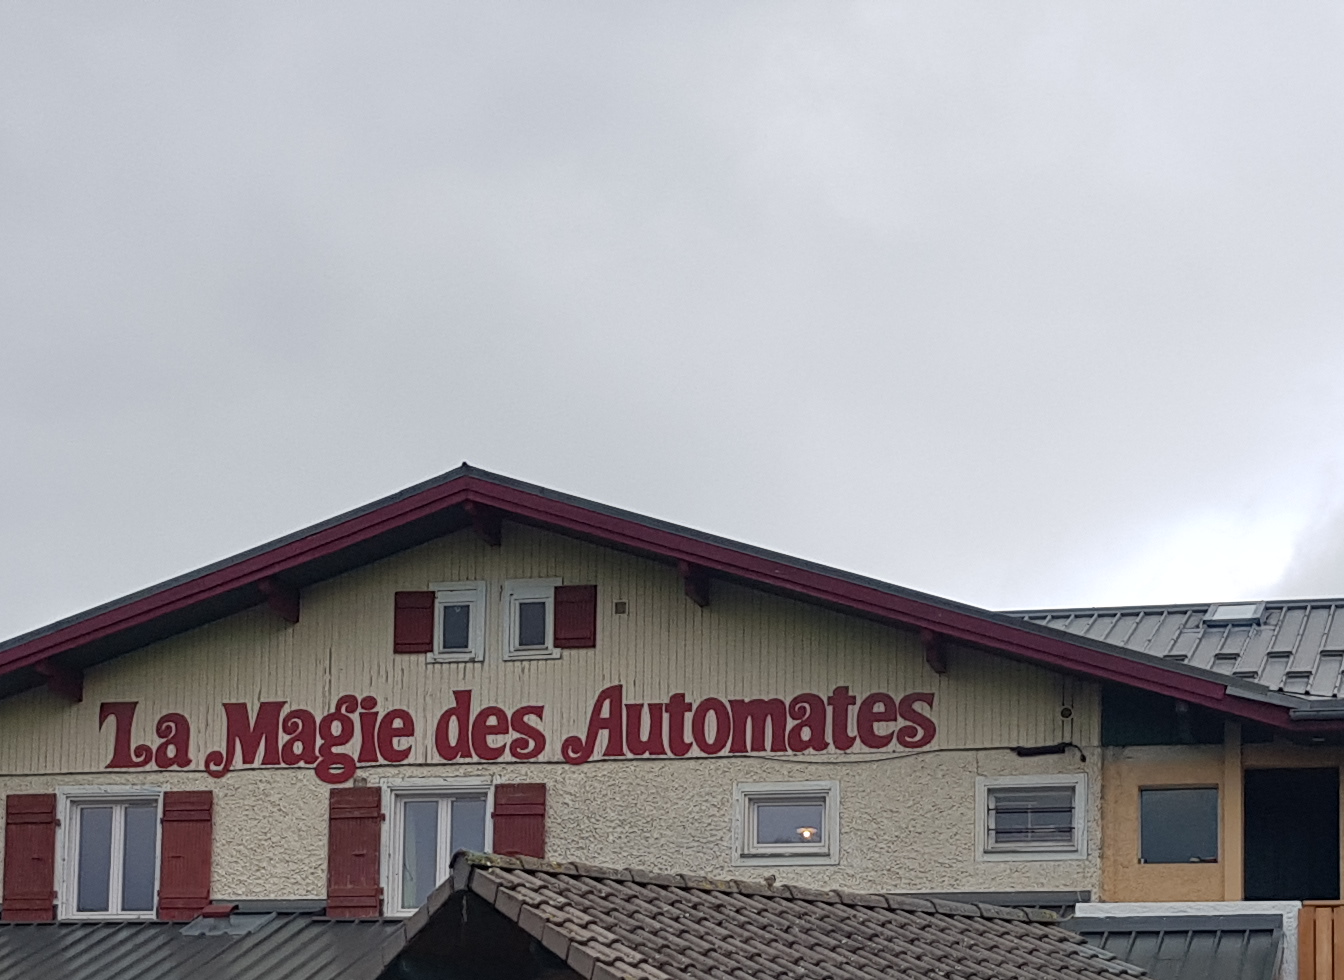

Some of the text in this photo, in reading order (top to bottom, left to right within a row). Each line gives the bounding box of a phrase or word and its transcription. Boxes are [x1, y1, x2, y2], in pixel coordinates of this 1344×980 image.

[99, 684, 938, 784] La Magie des Automates
